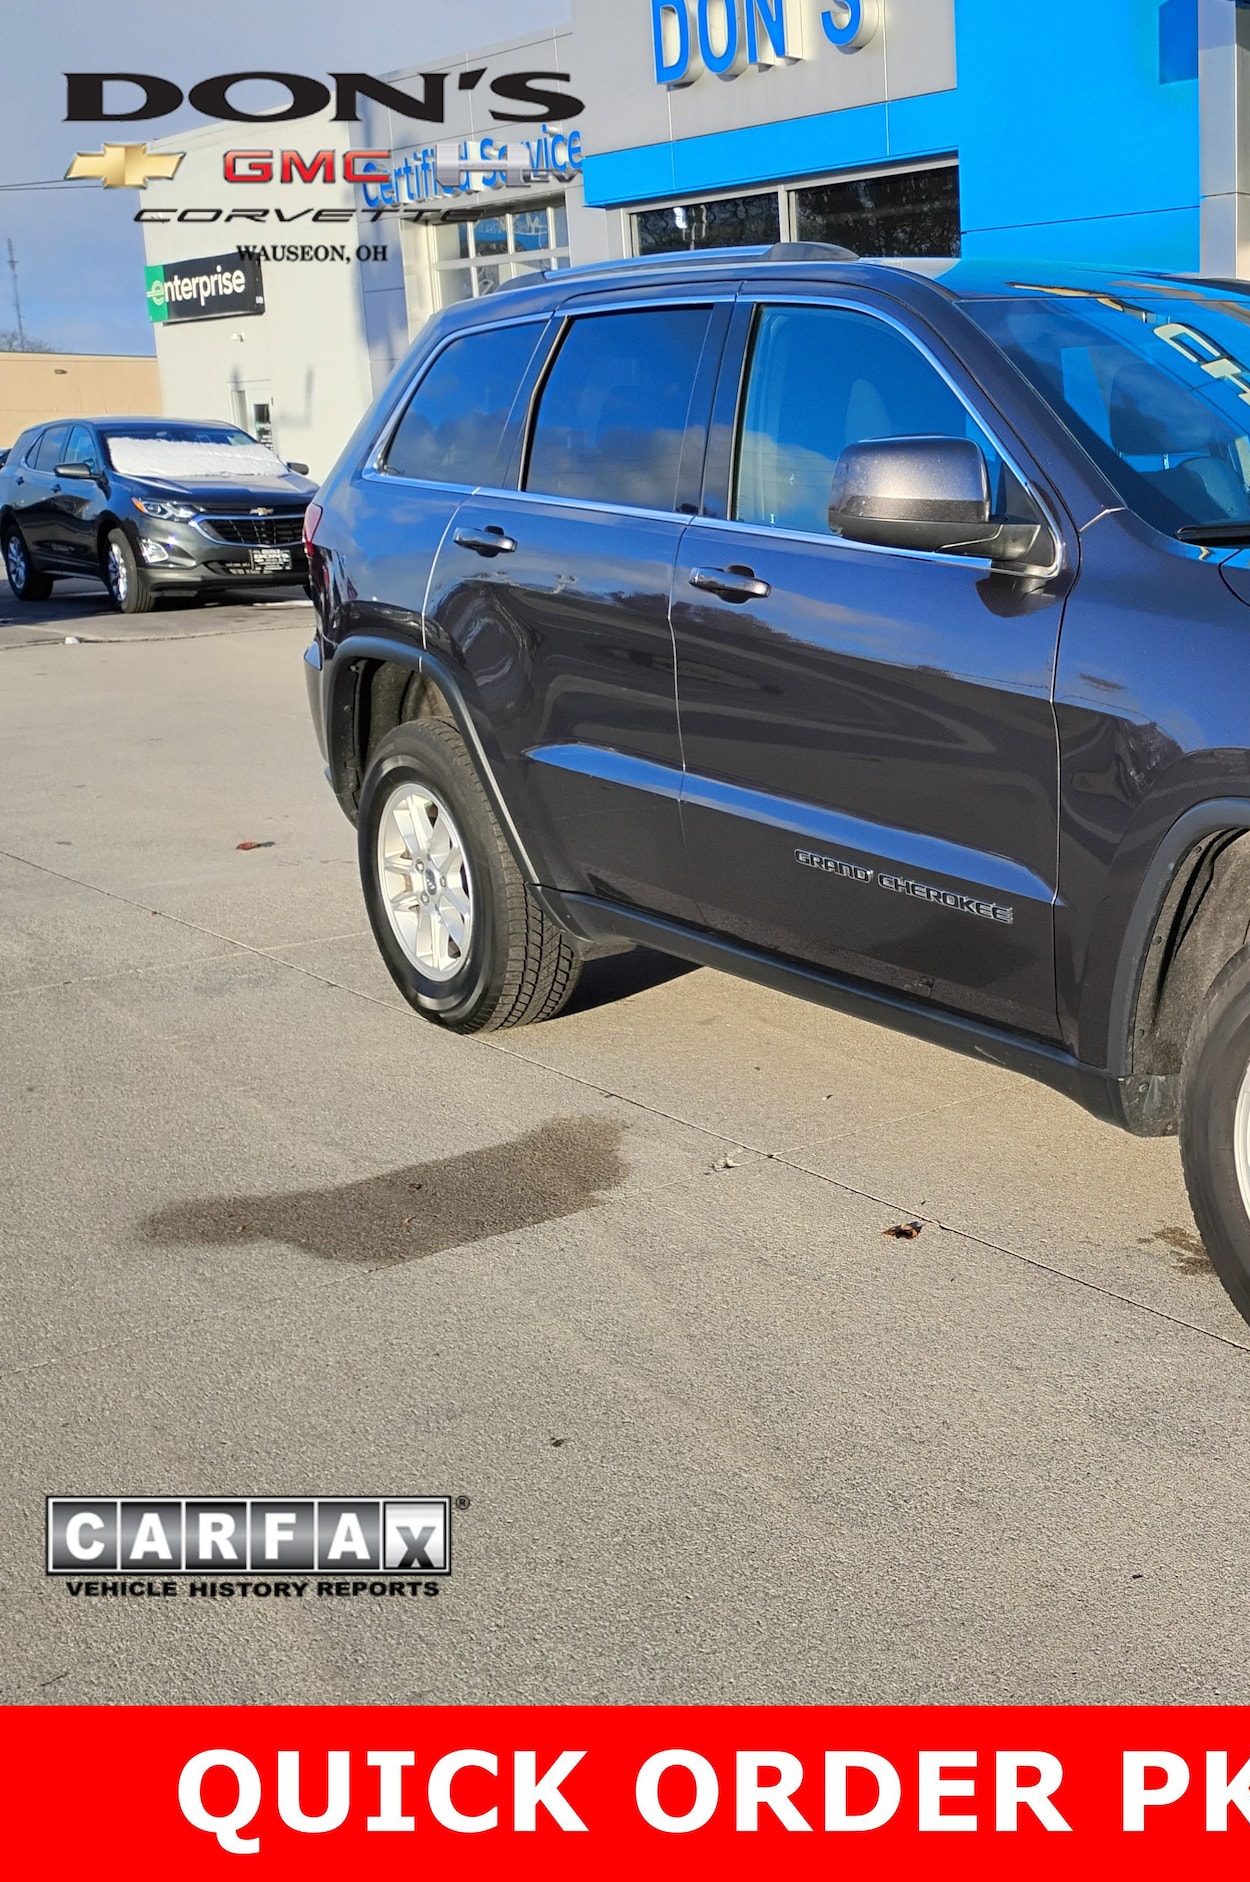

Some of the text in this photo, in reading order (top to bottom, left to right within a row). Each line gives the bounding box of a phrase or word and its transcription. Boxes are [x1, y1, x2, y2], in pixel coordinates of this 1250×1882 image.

[146, 264, 246, 306] enterprise
[794, 849, 1014, 924] GRAND CHEROKEE
